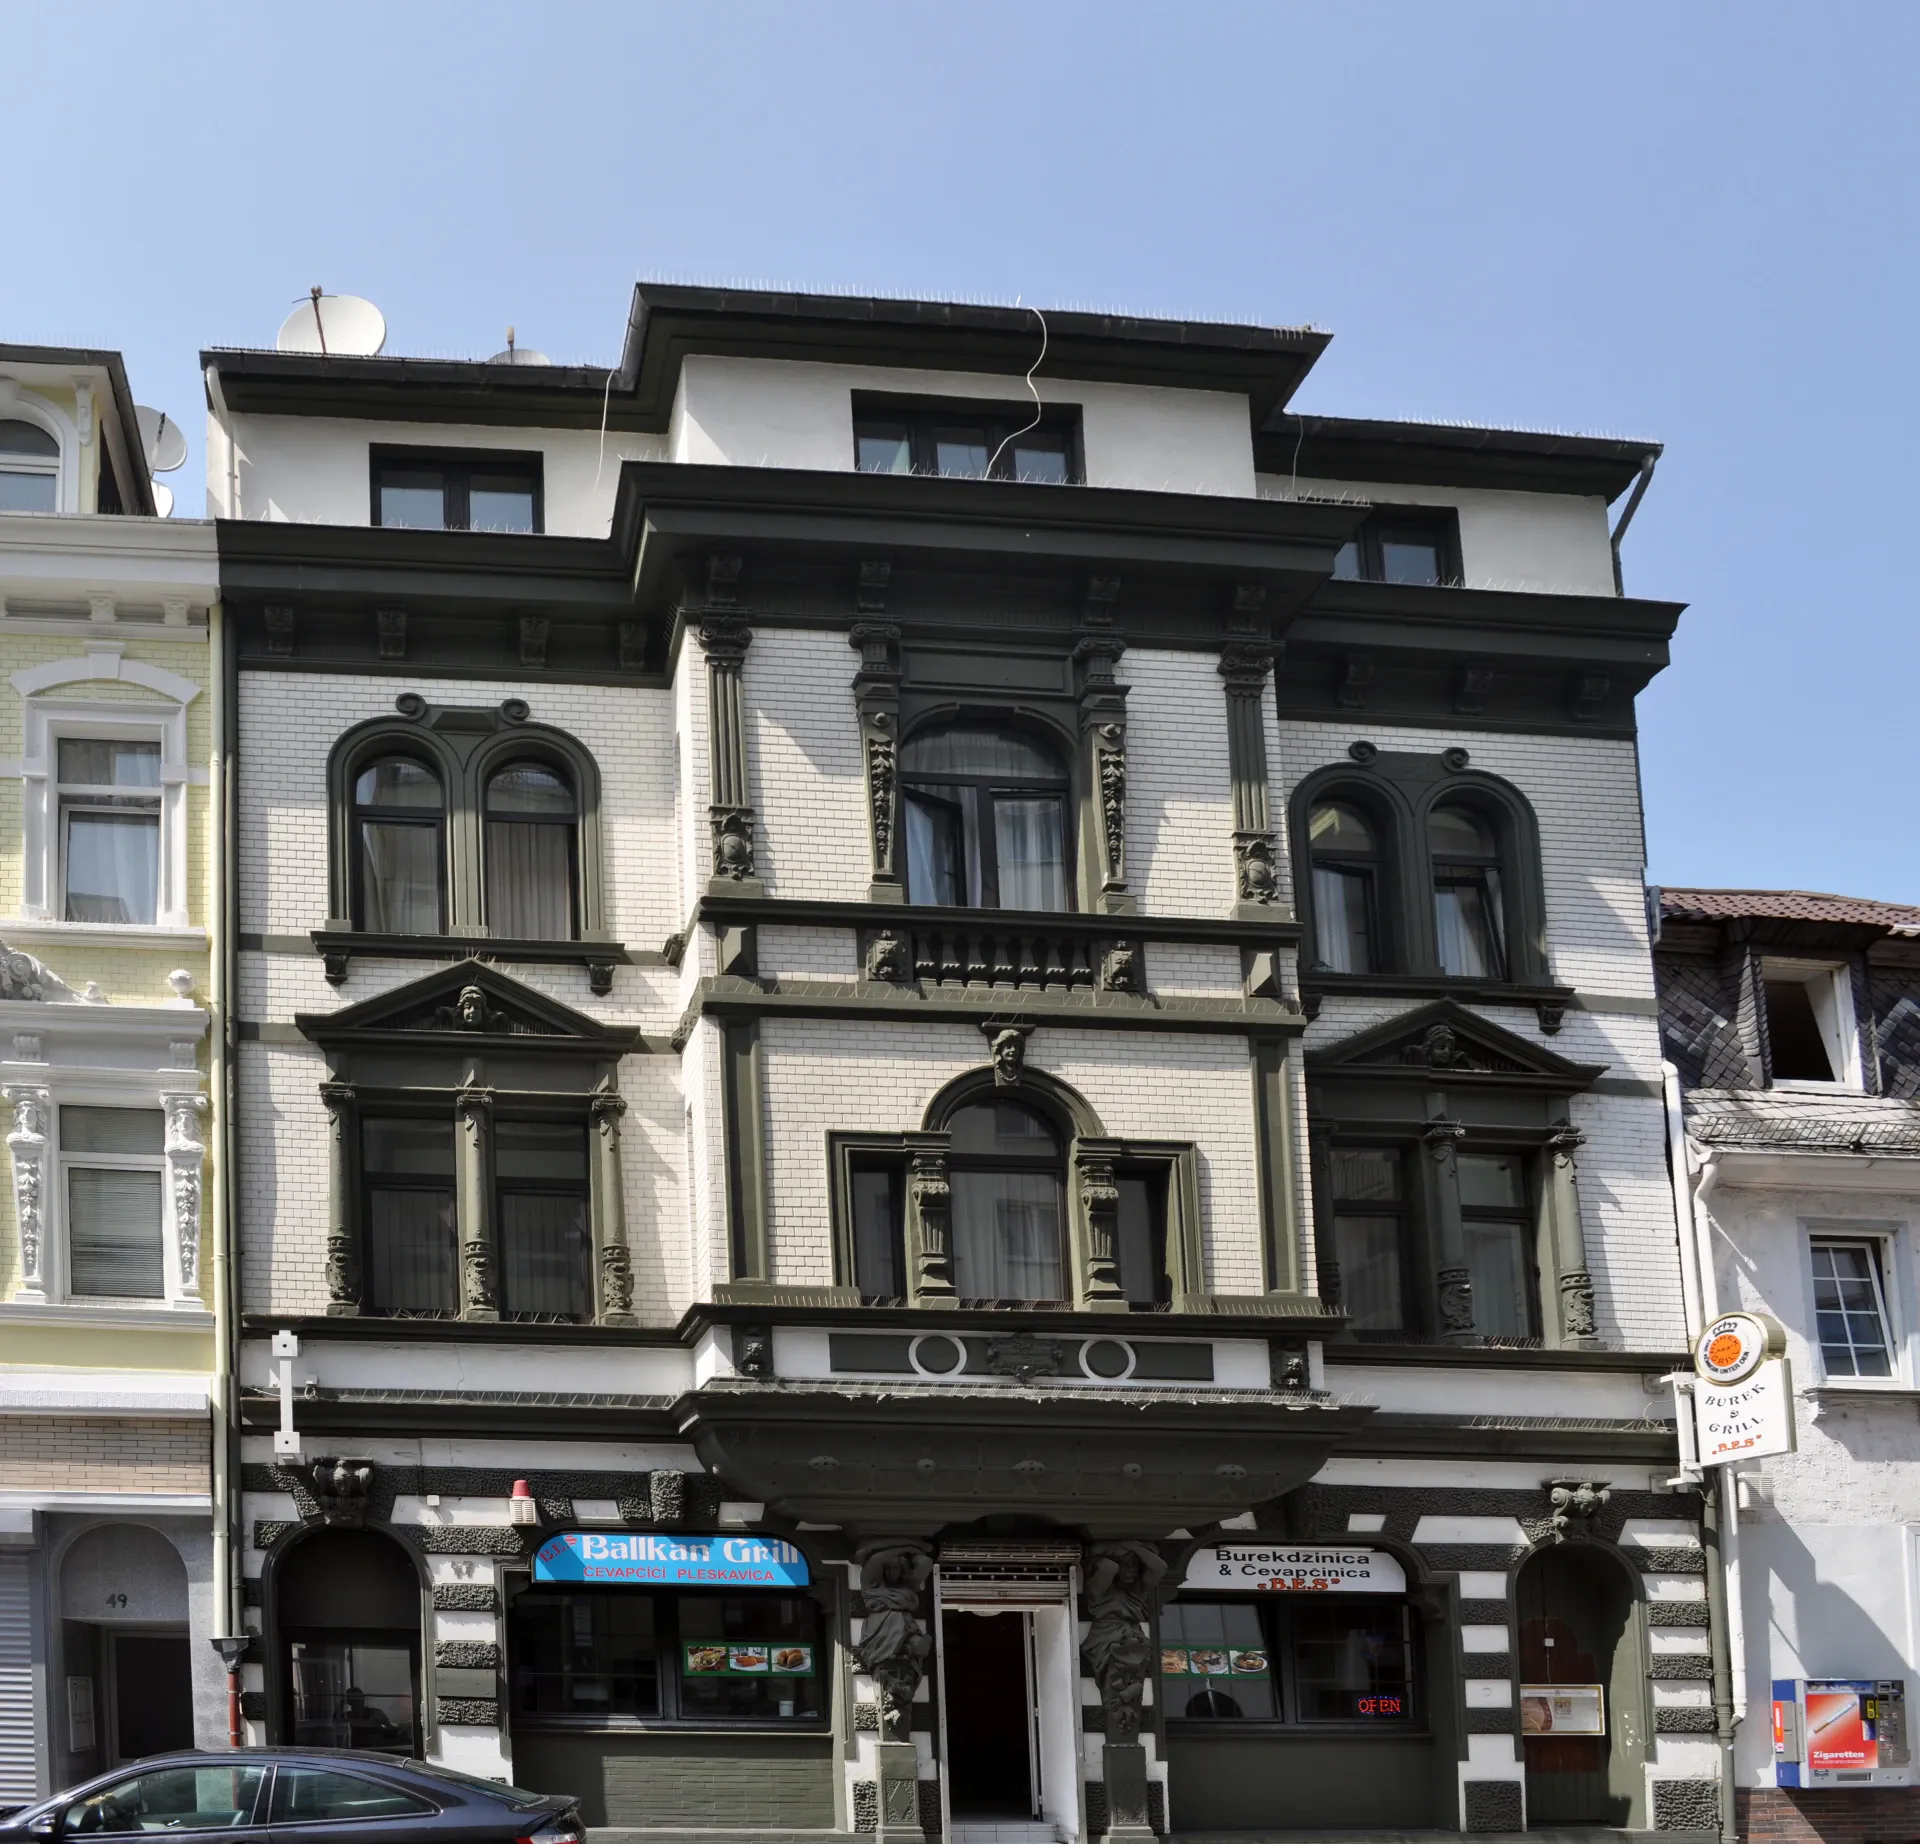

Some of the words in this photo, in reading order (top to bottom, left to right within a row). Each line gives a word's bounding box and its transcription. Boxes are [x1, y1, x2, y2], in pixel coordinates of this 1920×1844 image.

[1720, 1364, 1741, 1374] UNTER
[1739, 1351, 1750, 1365] DEN
[1704, 1383, 1766, 1407] BUREK
[1729, 1409, 1740, 1419] &
[1708, 1417, 1764, 1435] GRILL
[582, 1534, 710, 1563] Ballkan
[723, 1538, 799, 1564] Grill
[1215, 1550, 1371, 1565] Burekdžinica
[1218, 1563, 1232, 1577] &
[1240, 1563, 1371, 1579] Čevapčinica
[105, 1593, 128, 1609] 49
[1813, 1750, 1865, 1760] Zigaretten
